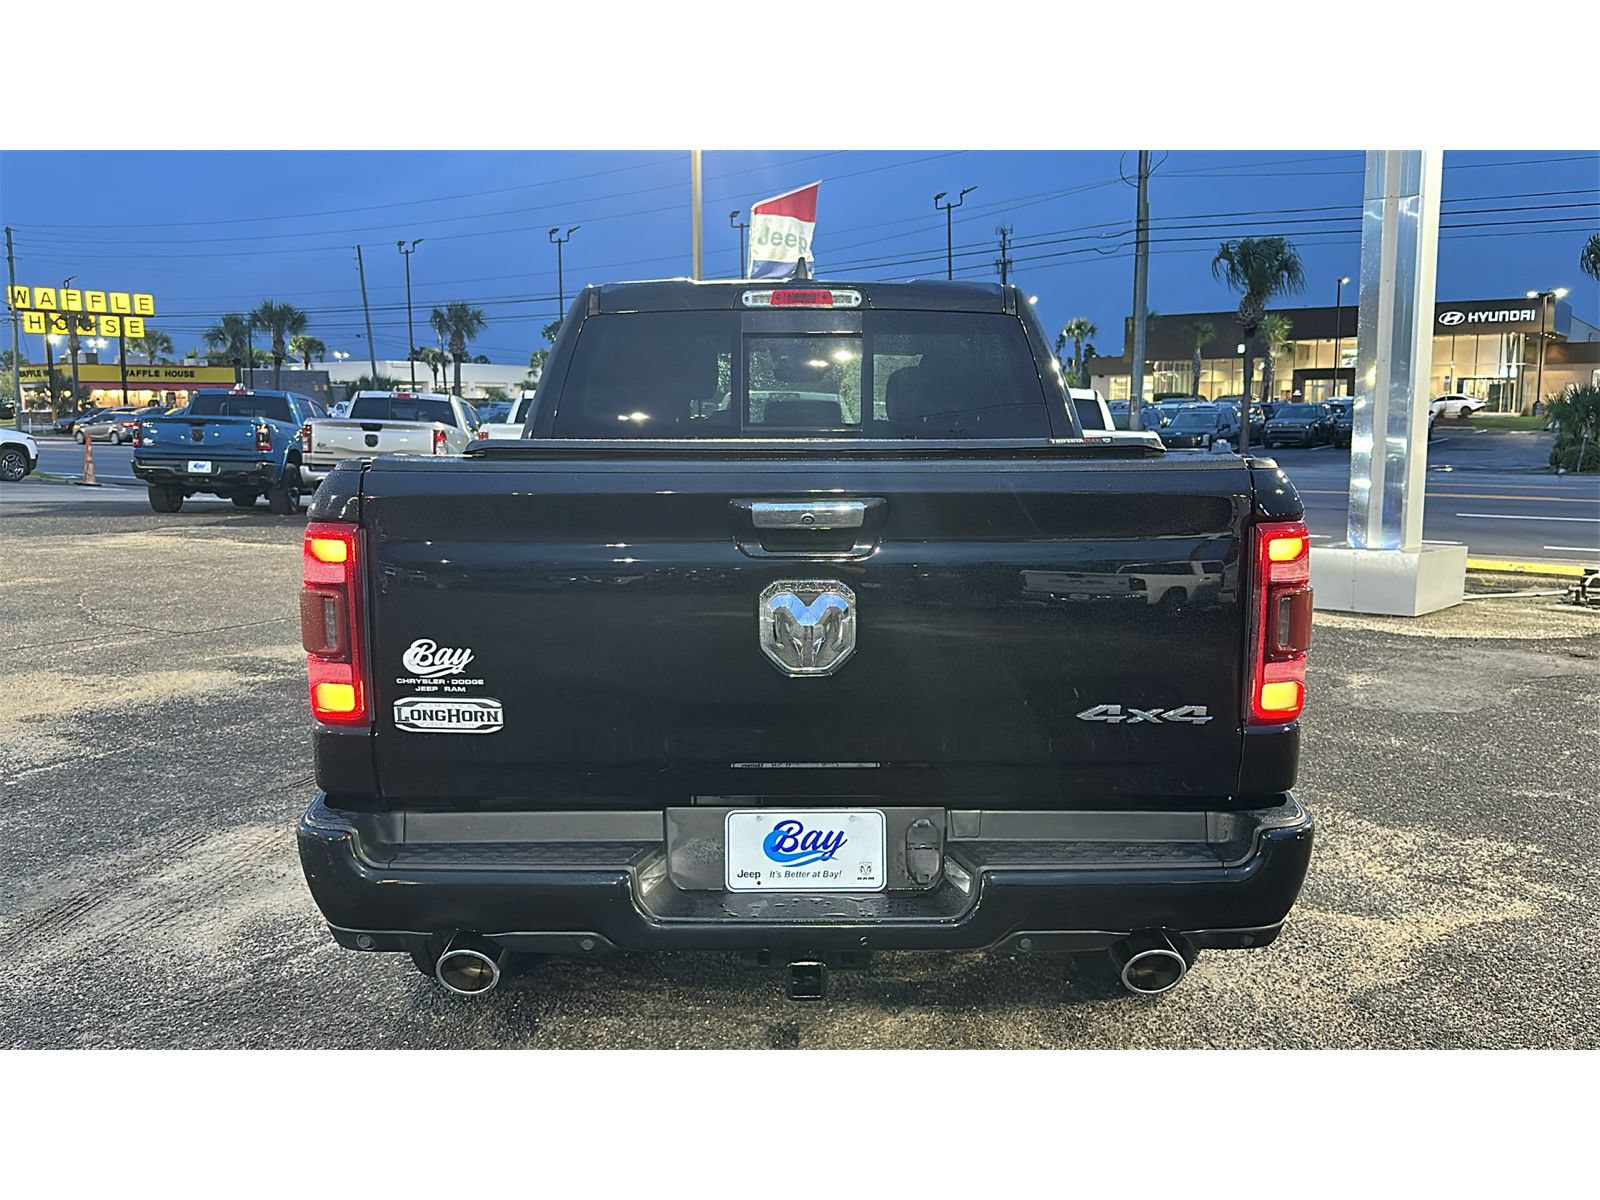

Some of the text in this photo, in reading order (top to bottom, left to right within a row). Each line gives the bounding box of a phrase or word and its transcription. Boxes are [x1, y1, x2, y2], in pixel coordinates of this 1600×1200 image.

[757, 226, 808, 254] Jeep
[13, 289, 151, 311] WAFFLE
[1467, 309, 1536, 323] HYUNDAI
[164, 370, 196, 378] HOUSE
[403, 638, 475, 677] Bay
[765, 819, 848, 864] Bay
[736, 869, 762, 880] Jeep
[769, 870, 842, 880] It's Better at Bay!
